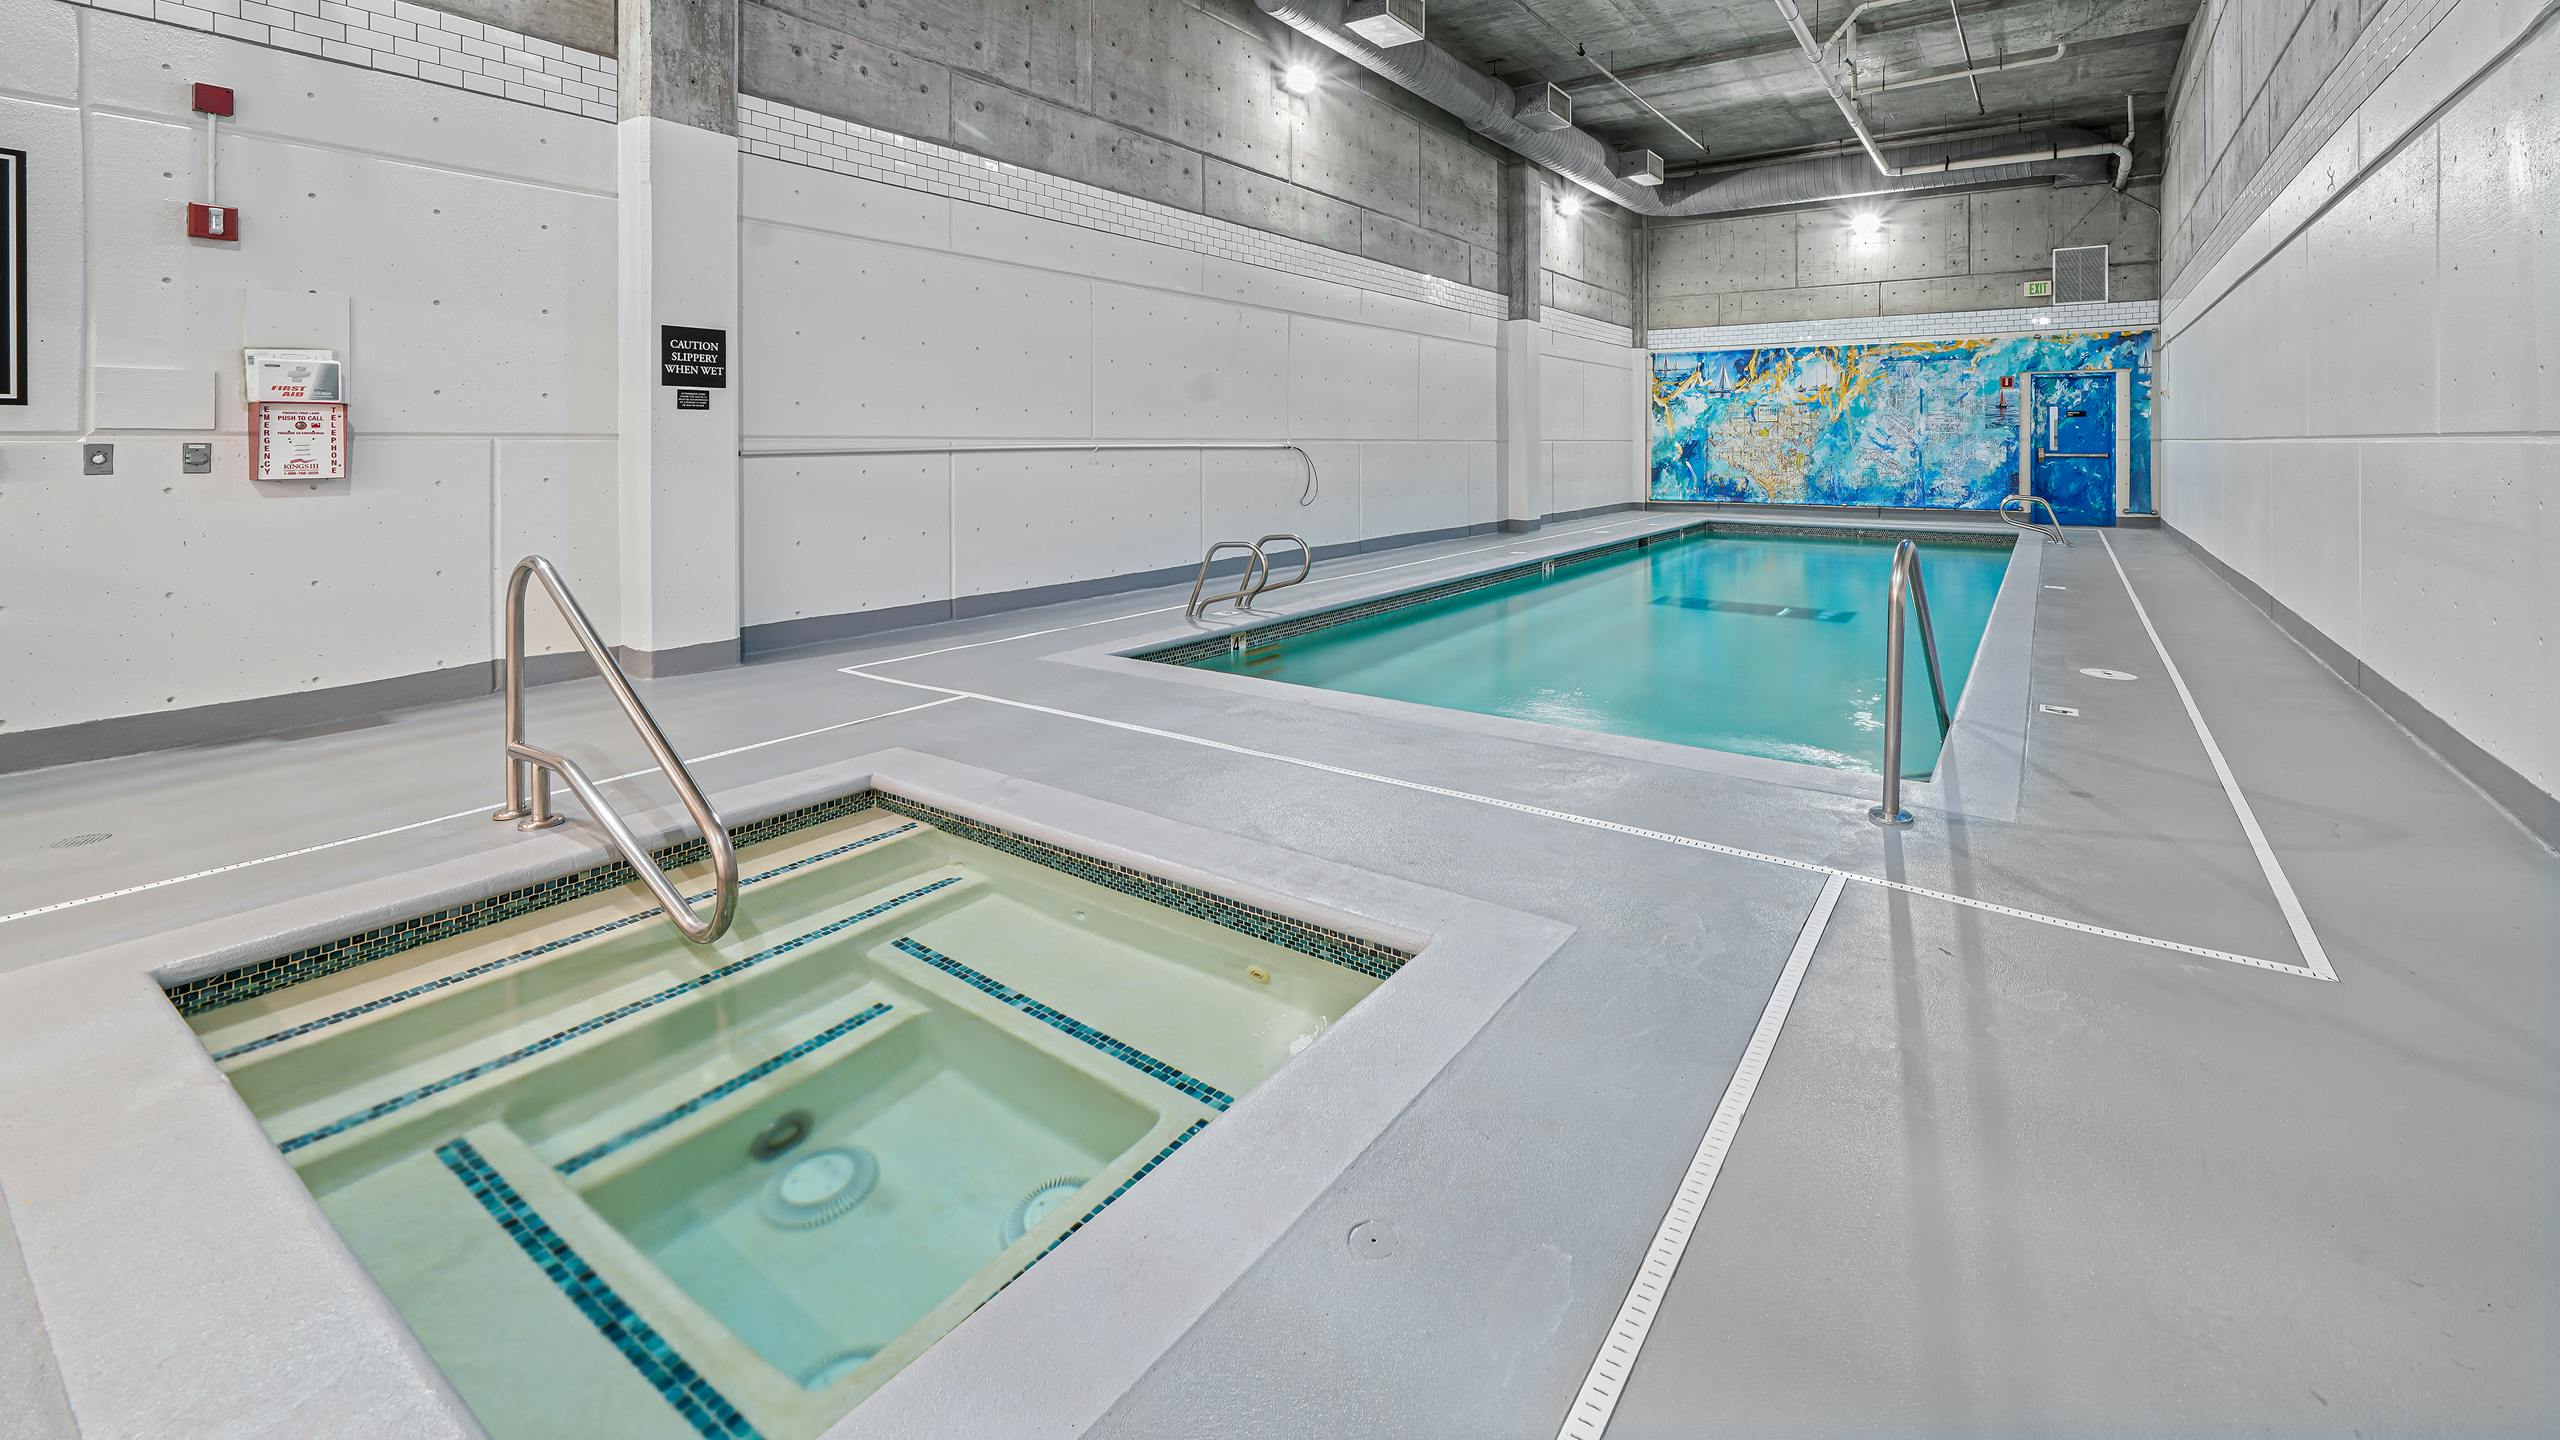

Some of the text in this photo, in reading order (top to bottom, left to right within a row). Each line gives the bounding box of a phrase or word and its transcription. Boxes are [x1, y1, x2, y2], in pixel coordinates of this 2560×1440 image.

[2029, 282, 2048, 294] EXIT
[670, 339, 719, 351] CAUTION
[671, 352, 718, 363] SLIPPERY
[664, 363, 724, 376] WHEN WET
